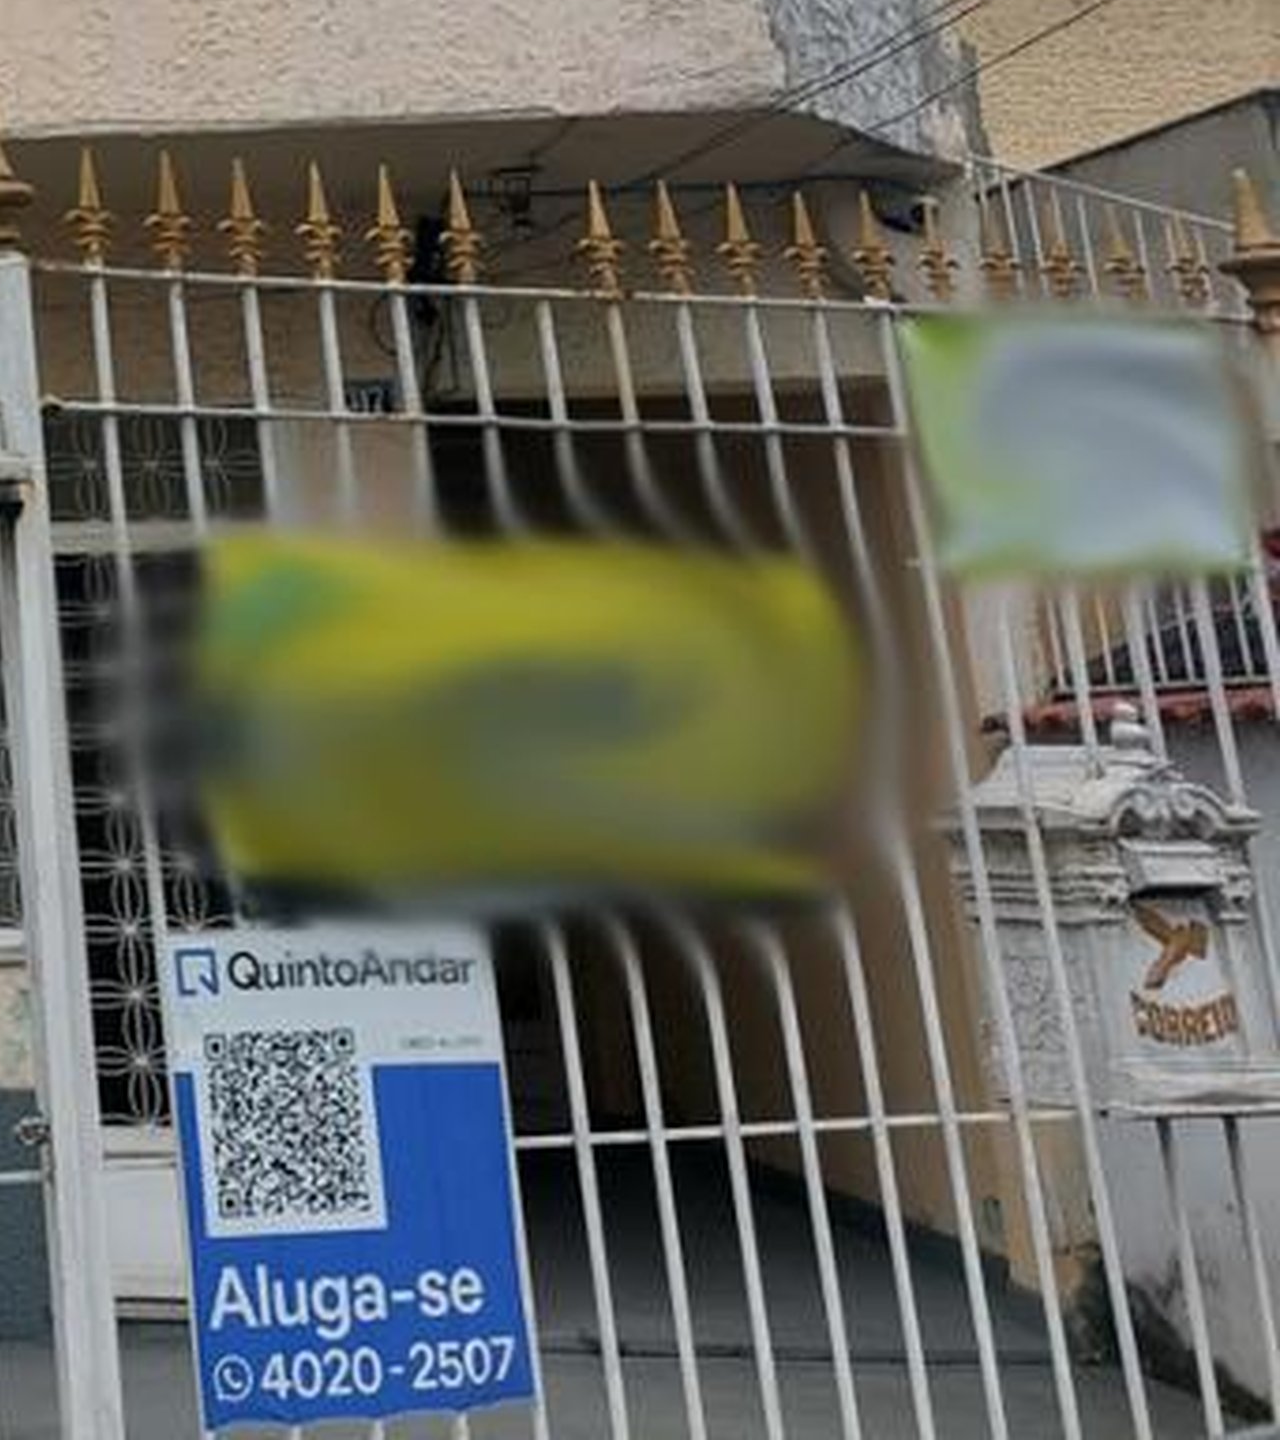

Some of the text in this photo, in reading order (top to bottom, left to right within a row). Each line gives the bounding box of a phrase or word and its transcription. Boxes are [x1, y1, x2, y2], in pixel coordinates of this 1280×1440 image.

[227, 950, 476, 990] QuintoAndar
[1130, 990, 1238, 1046] CORREIO
[210, 1264, 485, 1340] Aluga-se
[260, 1335, 515, 1401] 4020-2507
